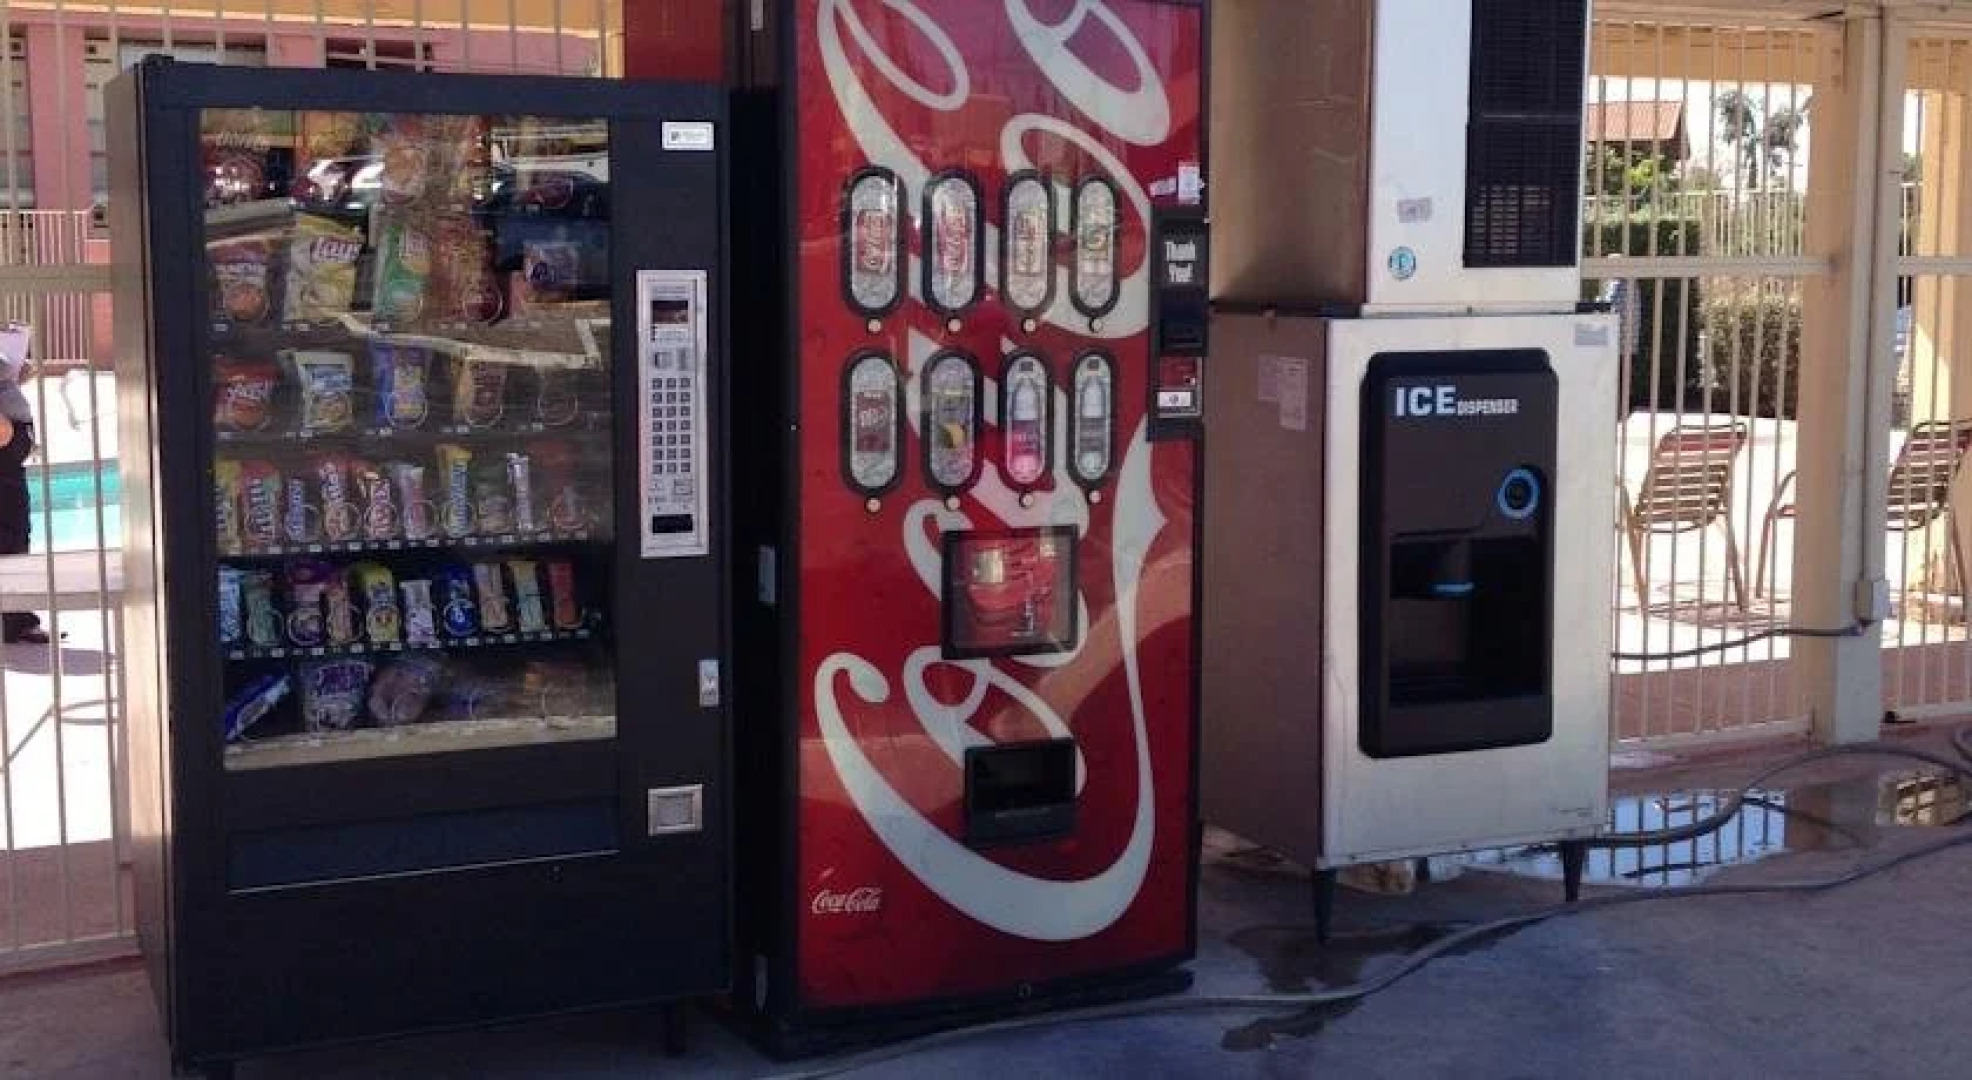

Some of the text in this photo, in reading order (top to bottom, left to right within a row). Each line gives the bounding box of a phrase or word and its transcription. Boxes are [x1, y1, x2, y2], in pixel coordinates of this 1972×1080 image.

[1164, 240, 1196, 261] Thank
[1396, 386, 1518, 416] ICE DISPENSER
